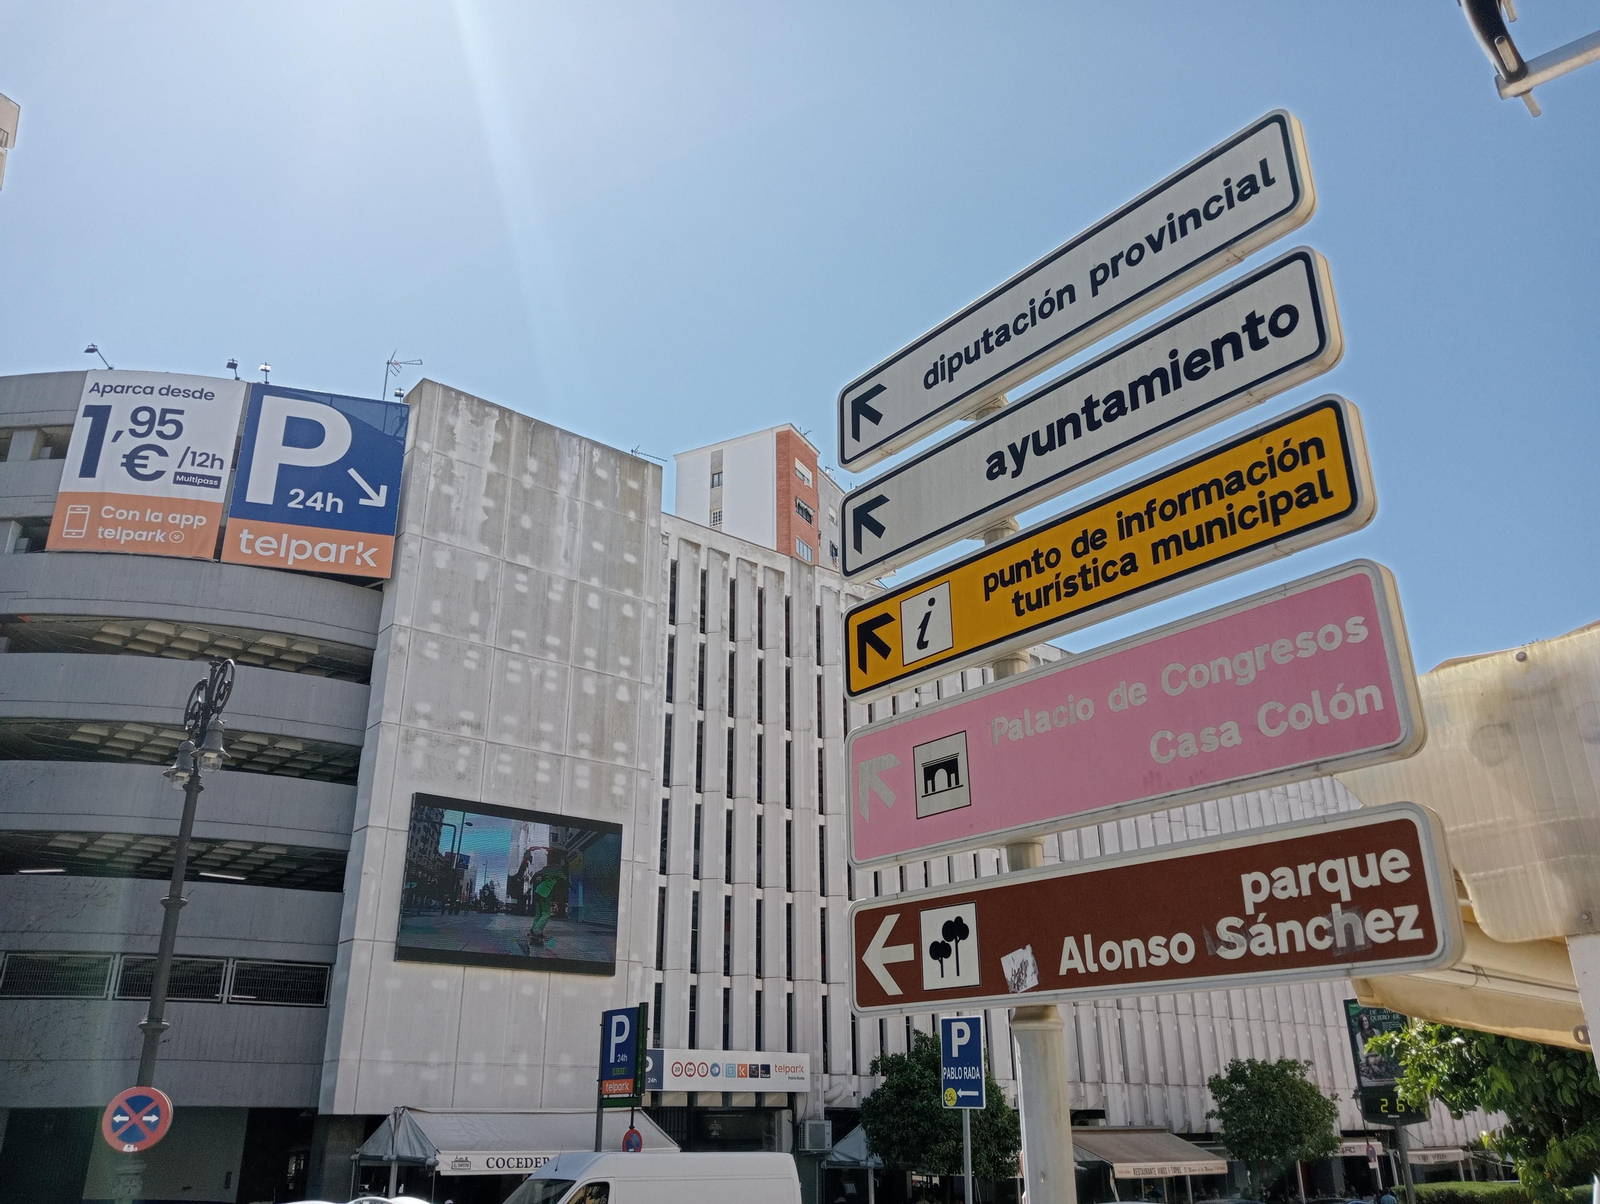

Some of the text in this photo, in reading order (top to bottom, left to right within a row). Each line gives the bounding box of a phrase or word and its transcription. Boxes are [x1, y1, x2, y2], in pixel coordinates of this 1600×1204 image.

[923, 158, 1276, 390] diputación provincial
[89, 382, 215, 401] Aparca desde
[985, 303, 1299, 481] ayuntamiento
[245, 395, 352, 505] P
[175, 474, 219, 486] Multipass
[101, 505, 207, 529] Con la app
[287, 488, 344, 514] 24h
[983, 435, 1325, 602] punto de información
[98, 526, 166, 544] telpark
[239, 528, 379, 568] telpark
[1012, 469, 1333, 618] turística municipal
[992, 614, 1369, 747] Palacio de Congresos
[1149, 683, 1383, 764] Casa Colón
[1241, 848, 1411, 912] parque
[1058, 903, 1424, 976] Alonso Sánchez
[609, 1014, 630, 1064] P
[617, 1053, 628, 1063] 24h
[951, 1021, 971, 1058] P
[605, 1082, 630, 1093] telpark
[774, 1063, 805, 1076] telpark
[943, 1066, 981, 1080] PABLO RADA
